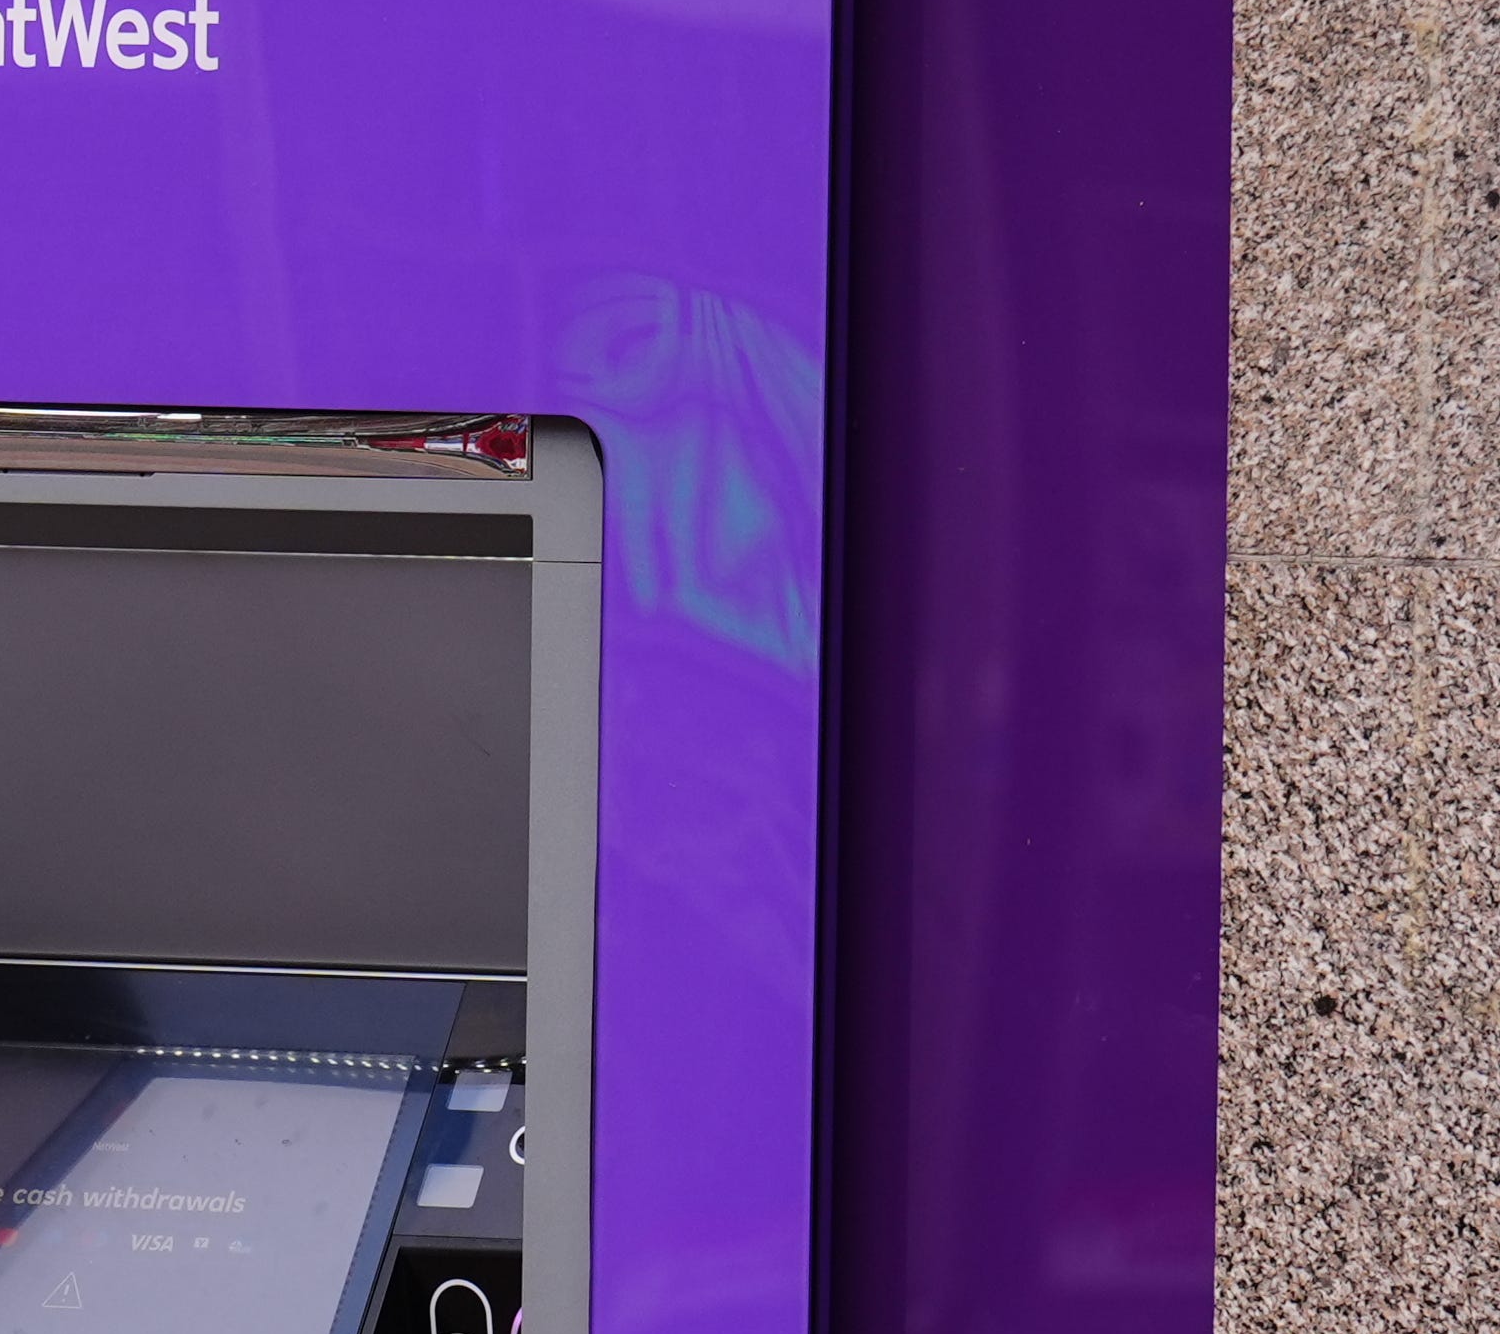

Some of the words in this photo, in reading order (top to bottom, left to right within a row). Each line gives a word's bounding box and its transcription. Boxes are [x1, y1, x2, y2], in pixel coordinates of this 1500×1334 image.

[12, 1184, 73, 1207] cash
[82, 1186, 247, 1214] withdrawals
[130, 1234, 175, 1252] VISA
